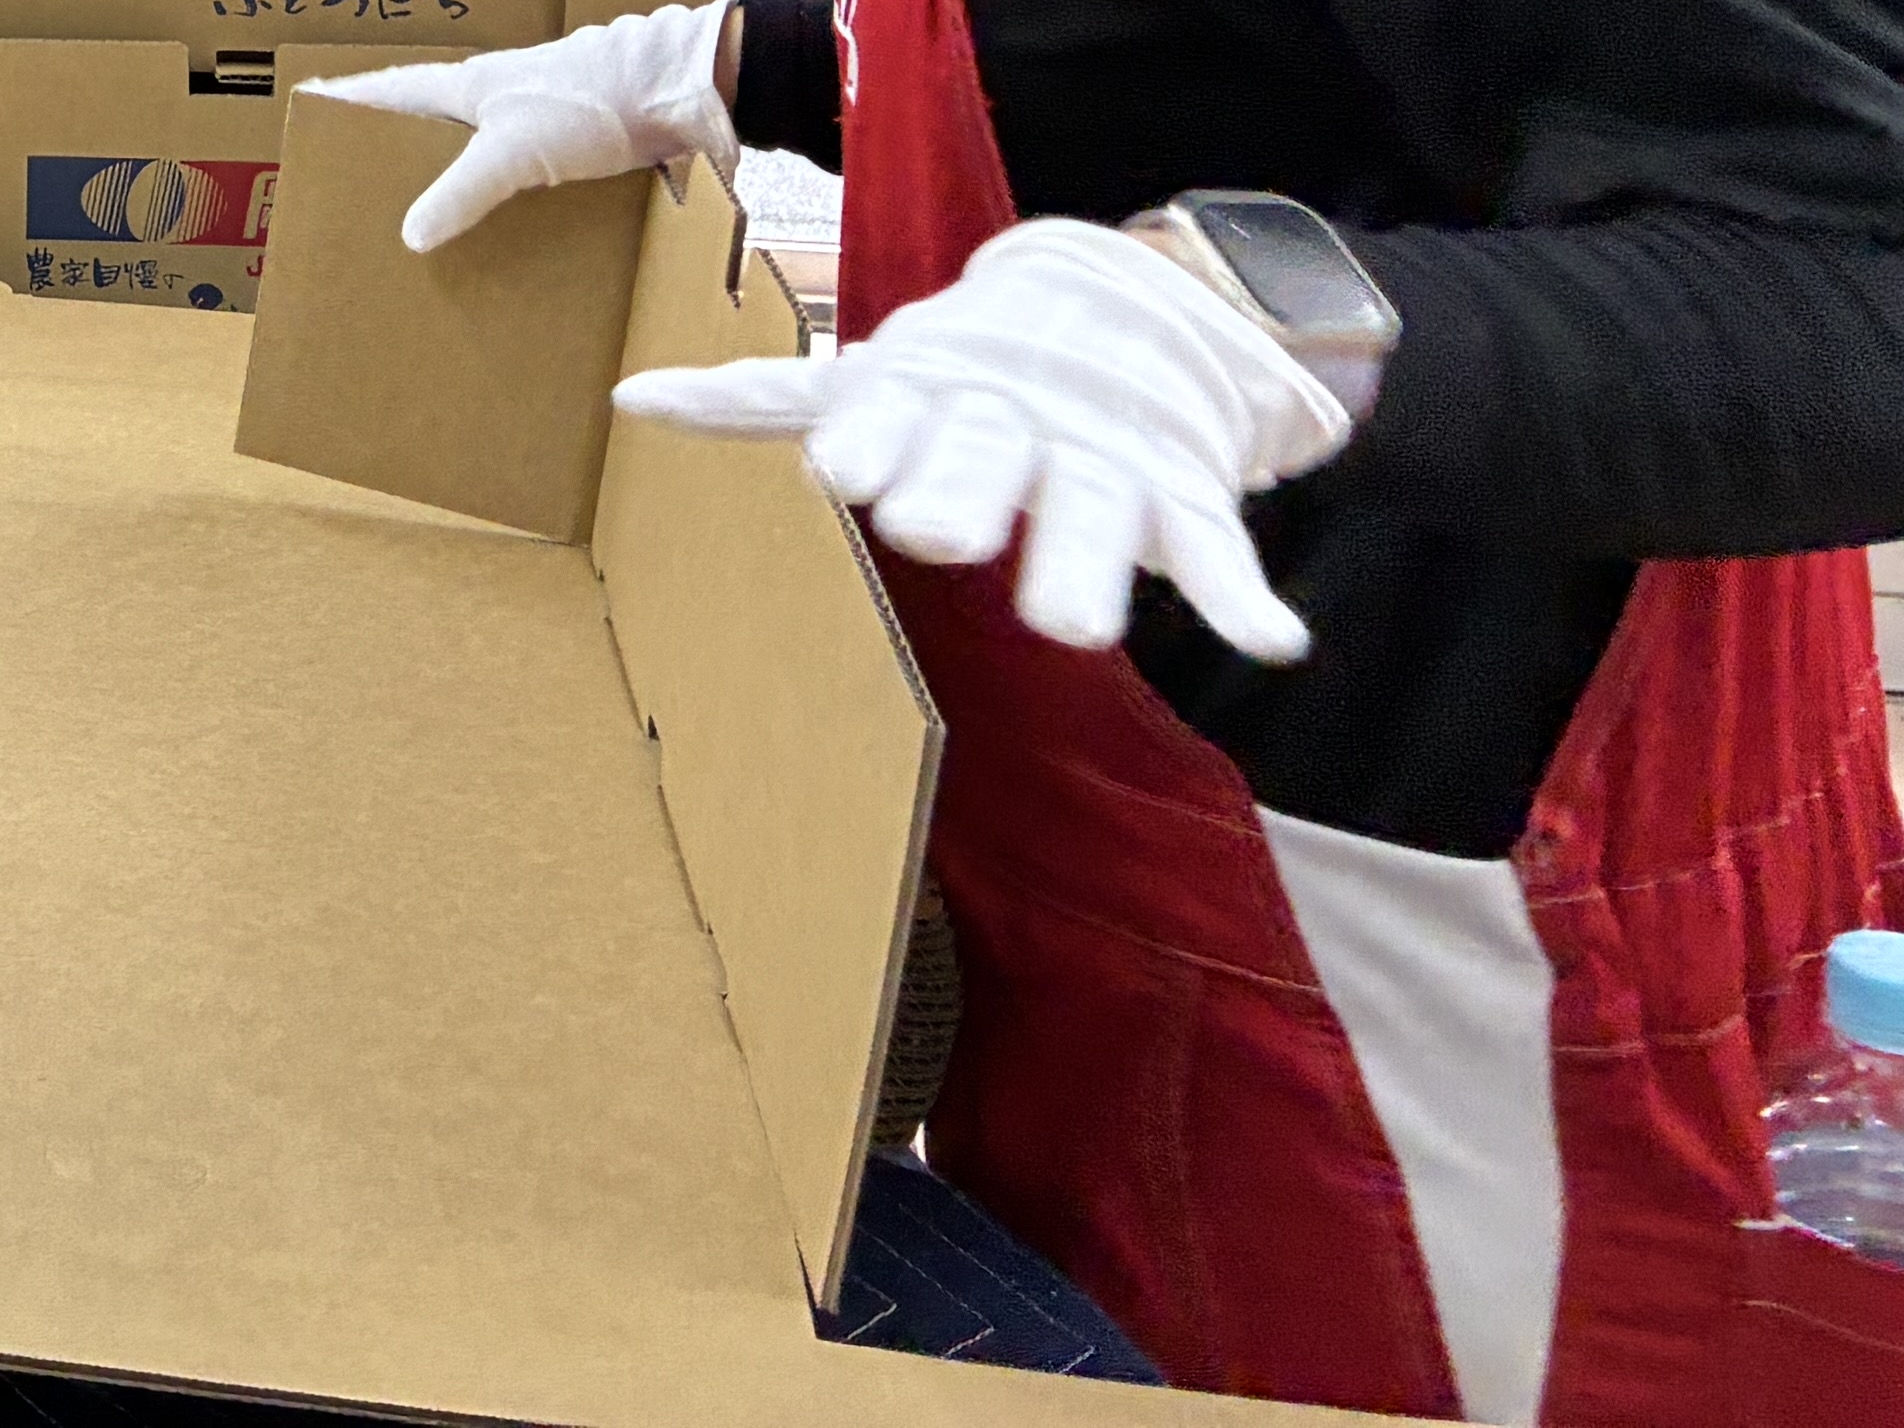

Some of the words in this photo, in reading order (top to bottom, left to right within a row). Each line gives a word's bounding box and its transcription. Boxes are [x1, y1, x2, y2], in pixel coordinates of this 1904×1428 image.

[26, 246, 184, 291] 農家自慢の
